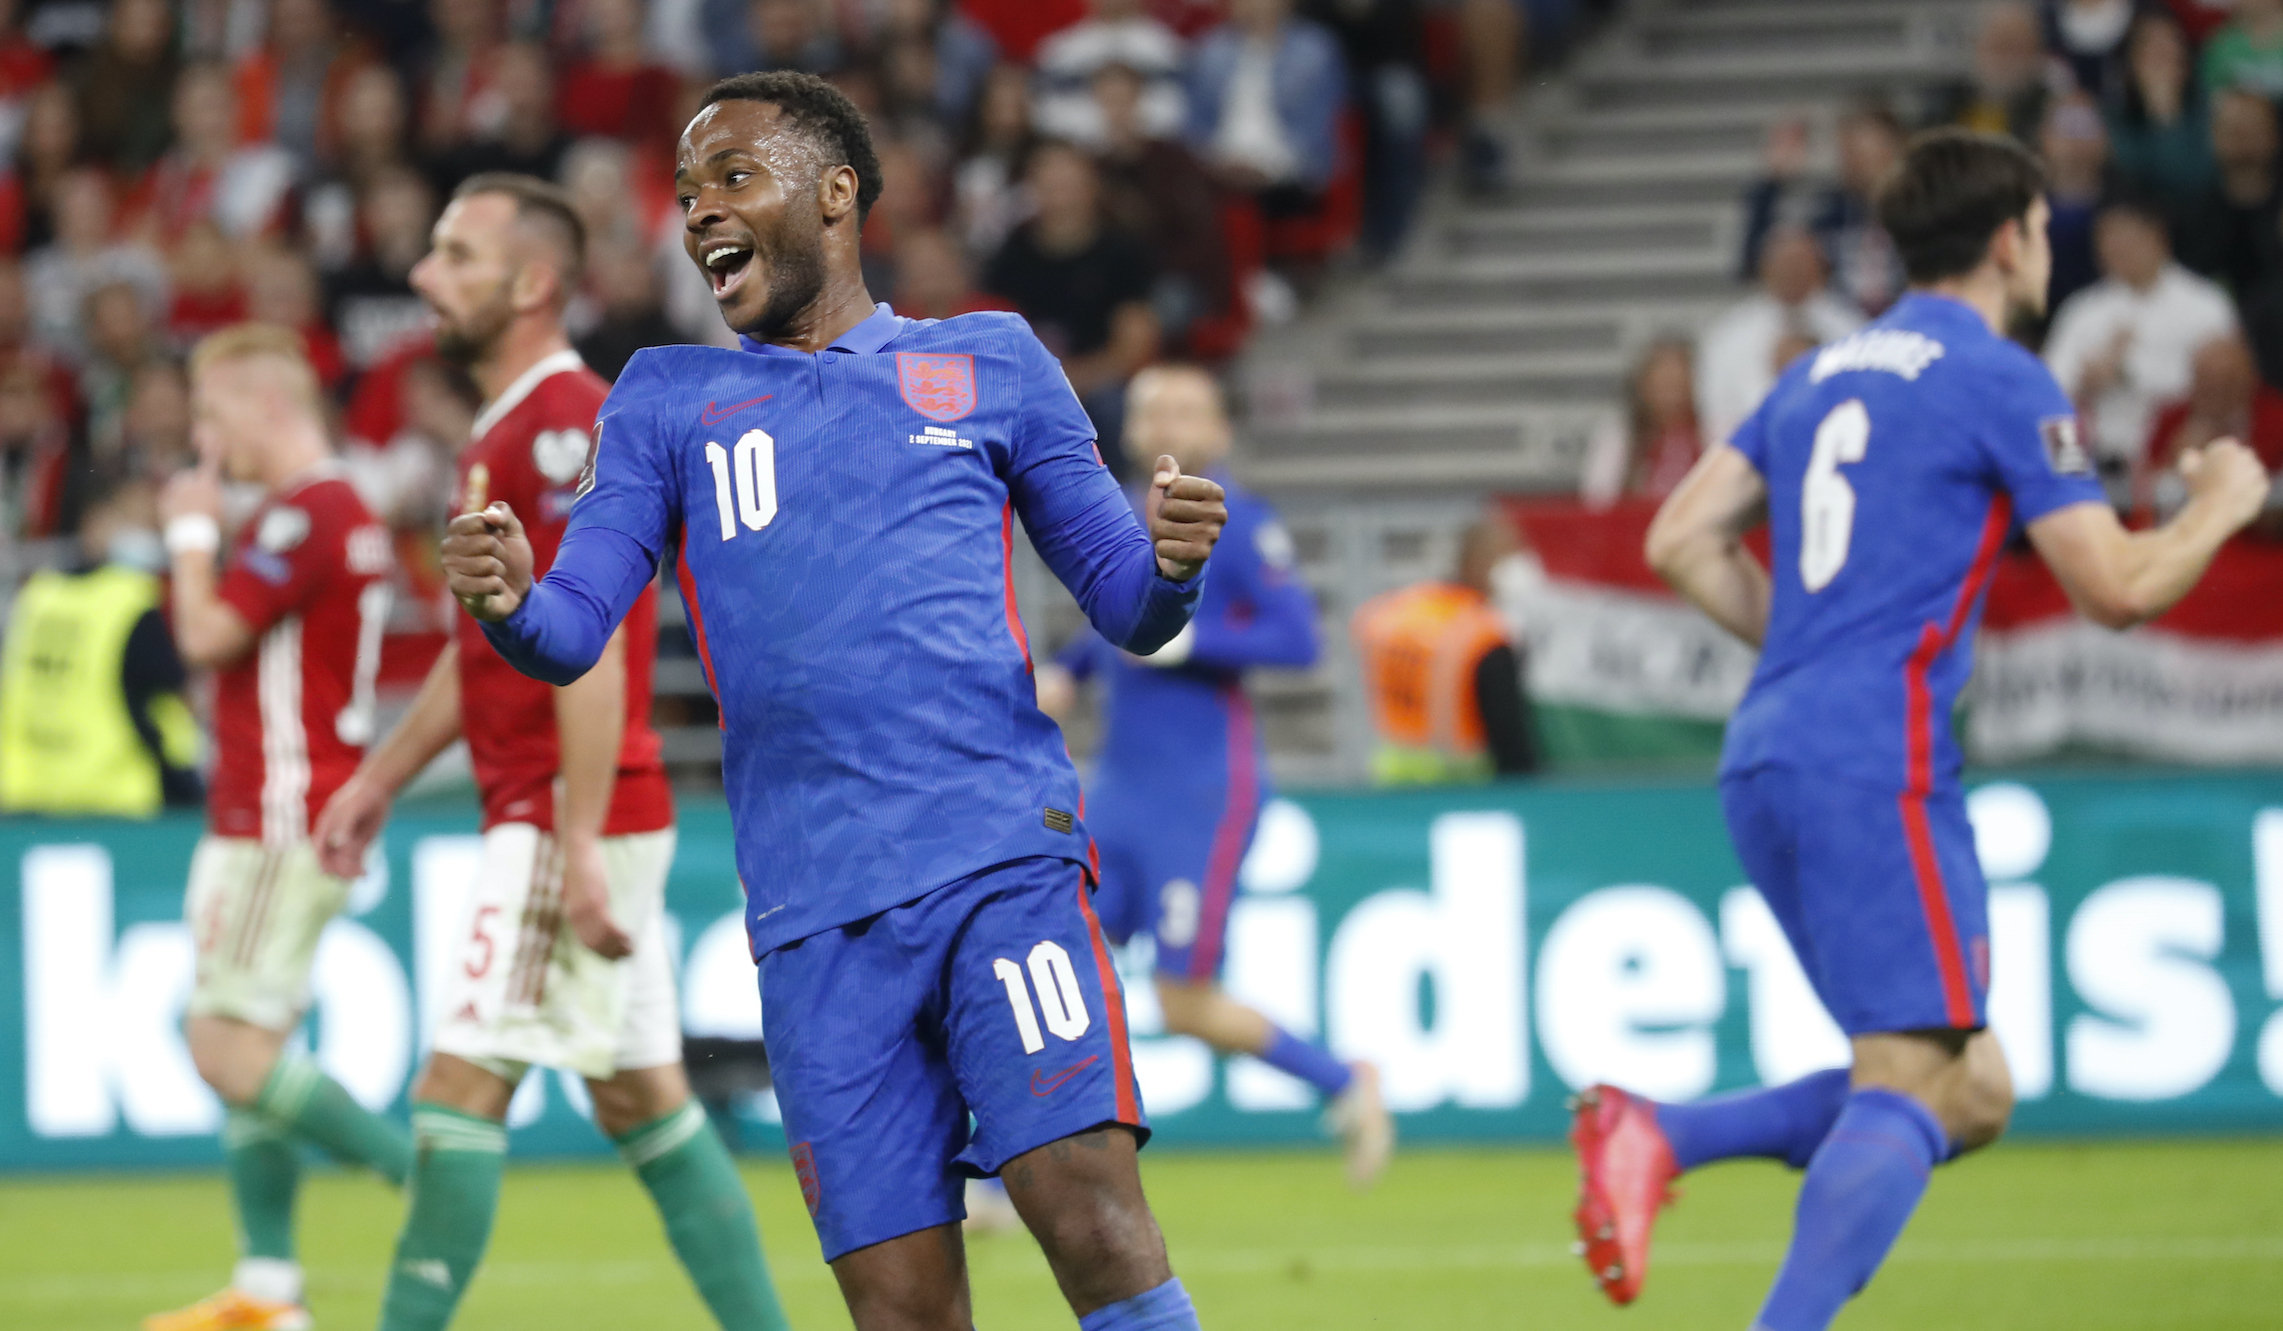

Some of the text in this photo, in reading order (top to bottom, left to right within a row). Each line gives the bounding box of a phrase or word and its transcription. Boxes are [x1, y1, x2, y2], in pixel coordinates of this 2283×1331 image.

[909, 434, 915, 444] 2
[916, 435, 957, 446] SEPTEMBER
[924, 426, 956, 438] HUNGARY
[705, 428, 778, 542] 10
[1800, 398, 1870, 594] 6
[463, 904, 502, 981] 5
[992, 940, 1090, 1055] 10
